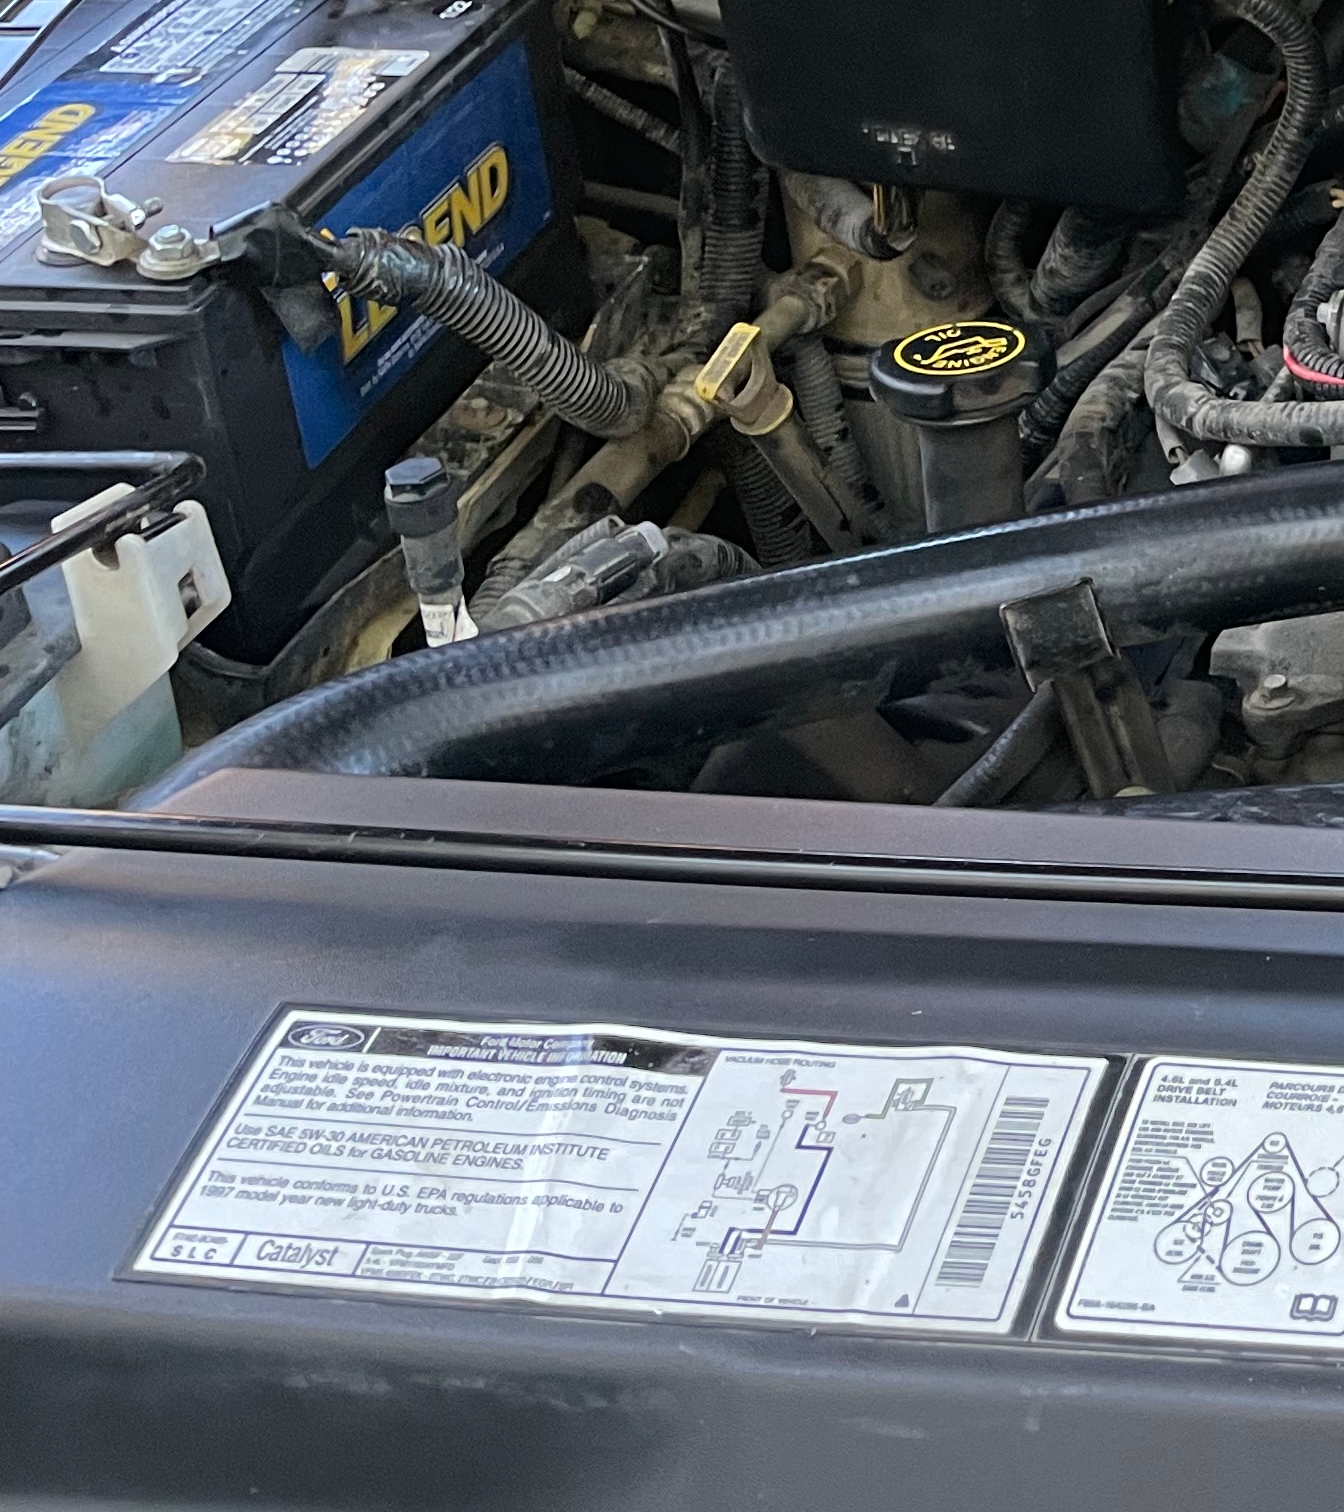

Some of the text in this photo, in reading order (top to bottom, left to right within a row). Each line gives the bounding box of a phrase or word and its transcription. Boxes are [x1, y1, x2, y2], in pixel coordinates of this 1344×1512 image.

[924, 328, 962, 342] OIL
[931, 346, 1007, 368] ENGINE
[300, 1026, 350, 1047] Ford
[480, 1035, 507, 1047] Ford
[508, 1036, 542, 1049] Motor
[427, 1045, 628, 1064] IMPORTANT VEHICLE INFORMATION
[278, 1055, 689, 1095] This vehicle is equipped with electronic engine control systems.
[1269, 1081, 1336, 1094] PARCOURS
[269, 1068, 318, 1083] Engine
[322, 1071, 348, 1085] idle
[404, 1078, 431, 1091] idle
[434, 1081, 491, 1097] mixture,
[496, 1085, 525, 1098] and
[528, 1087, 578, 1101] ignition
[581, 1086, 627, 1104] timing
[631, 1092, 656, 1105] are
[661, 1096, 686, 1108] not
[1153, 1094, 1237, 1107] INSTALLATION
[1156, 1084, 1226, 1096] DRIVE BELT
[251, 1094, 474, 1122] Manual for additional information.
[262, 1082, 337, 1098] adjustable.
[345, 1087, 375, 1100] See
[379, 1090, 459, 1107] Powertrain
[603, 1101, 678, 1122] Diagnosis
[1262, 1100, 1323, 1113] MOTEURS
[226, 1136, 524, 1170] CERTIFIED OILS for GASOLINE ENGINES.
[234, 1123, 610, 1161] Use SAE 5W-30 AMERICAN PETROLEUM INSTITUTE
[208, 1170, 624, 1214] This vehicle conforms to U.S. EPA regulations applicable to
[235, 1188, 280, 1202] model
[278, 1193, 314, 1206] year
[314, 1196, 344, 1207] new
[347, 1195, 412, 1215] light-duty
[414, 1202, 459, 1216] trucks.
[256, 1239, 339, 1269] Catalyst
